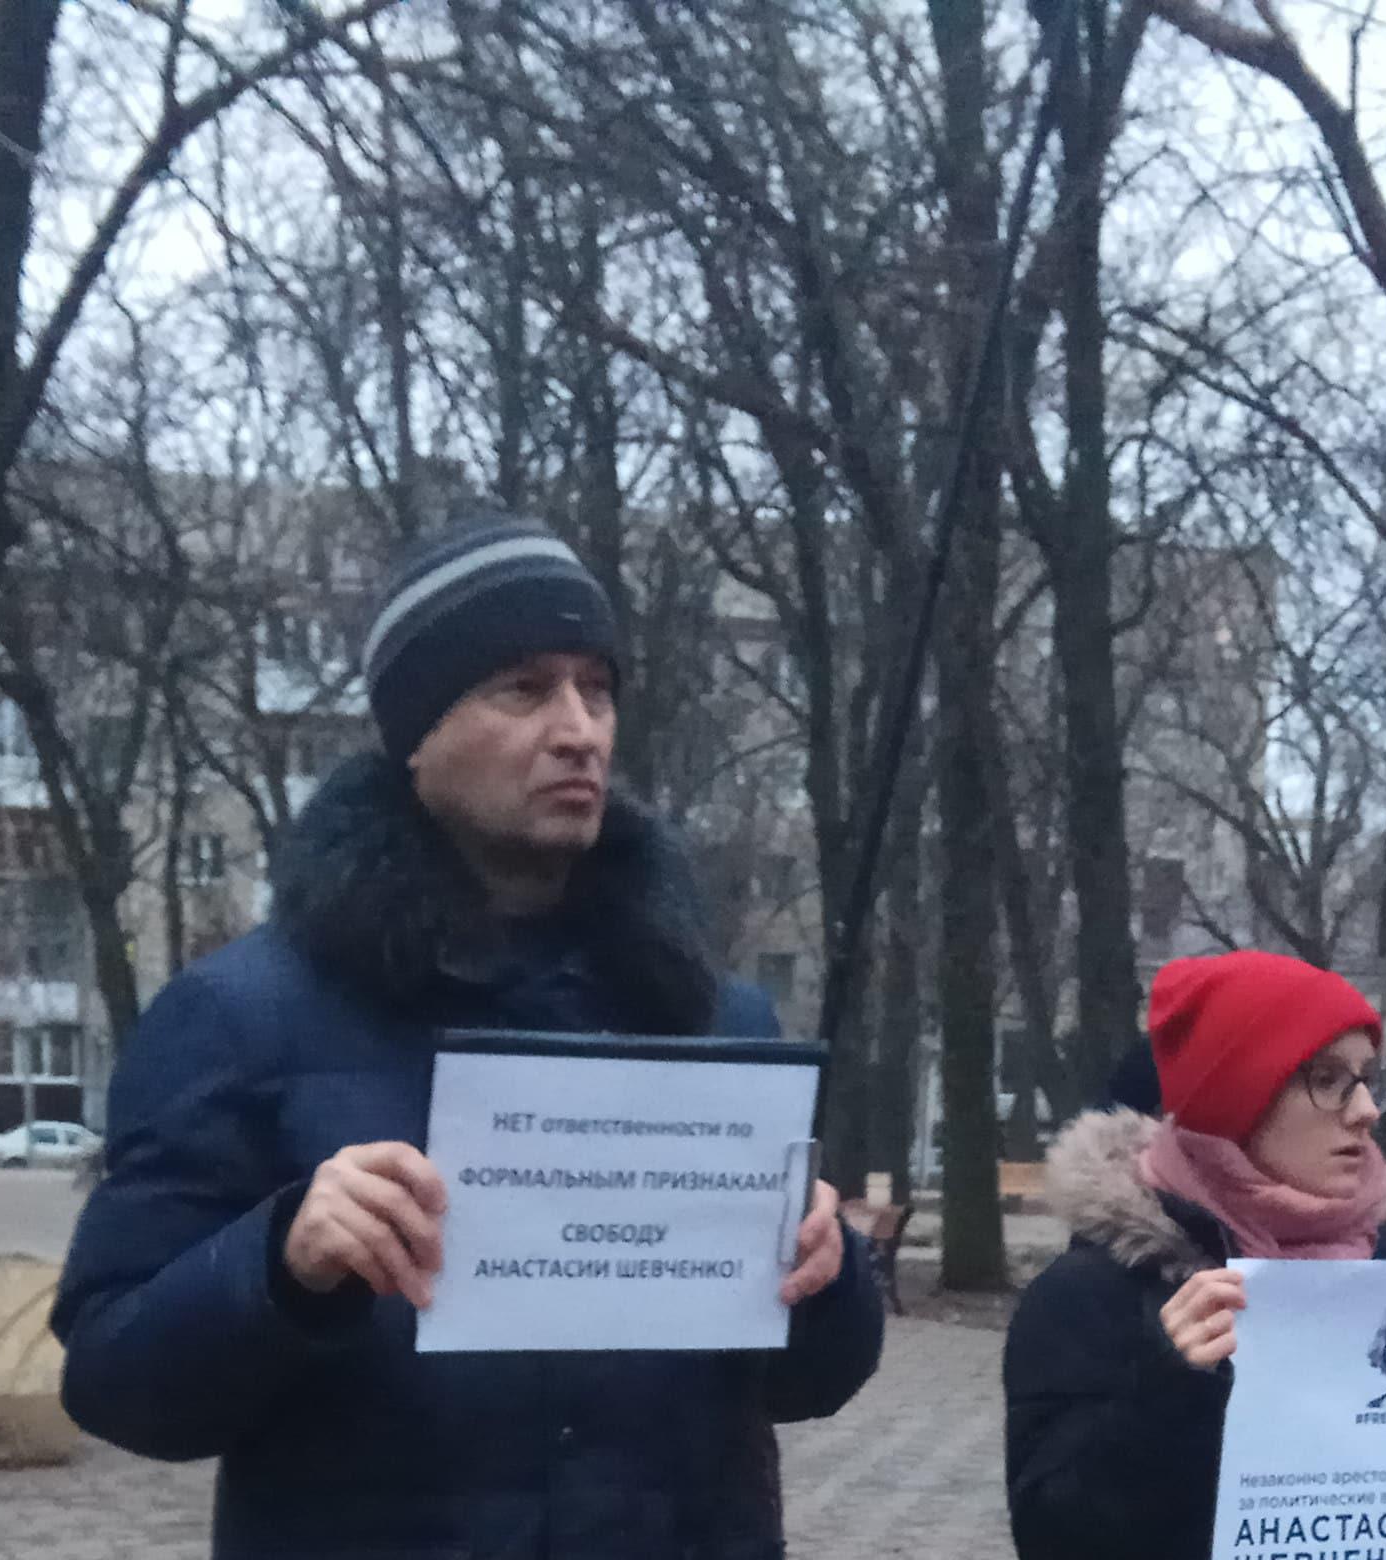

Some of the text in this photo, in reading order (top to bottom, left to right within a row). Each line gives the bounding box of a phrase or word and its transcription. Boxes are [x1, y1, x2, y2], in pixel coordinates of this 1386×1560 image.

[493, 1111, 753, 1138] НЕТ ответственности по
[459, 1166, 635, 1190] ФОРМАЛЬНЫМ
[562, 1222, 668, 1247] СВОБОДУ
[474, 1258, 744, 1280] АНАСТАСИИ ШЕВЧЕНКО!
[1239, 1471, 1328, 1488] Незаконно
[1238, 1496, 1255, 1511] за
[1258, 1492, 1376, 1509] политические
